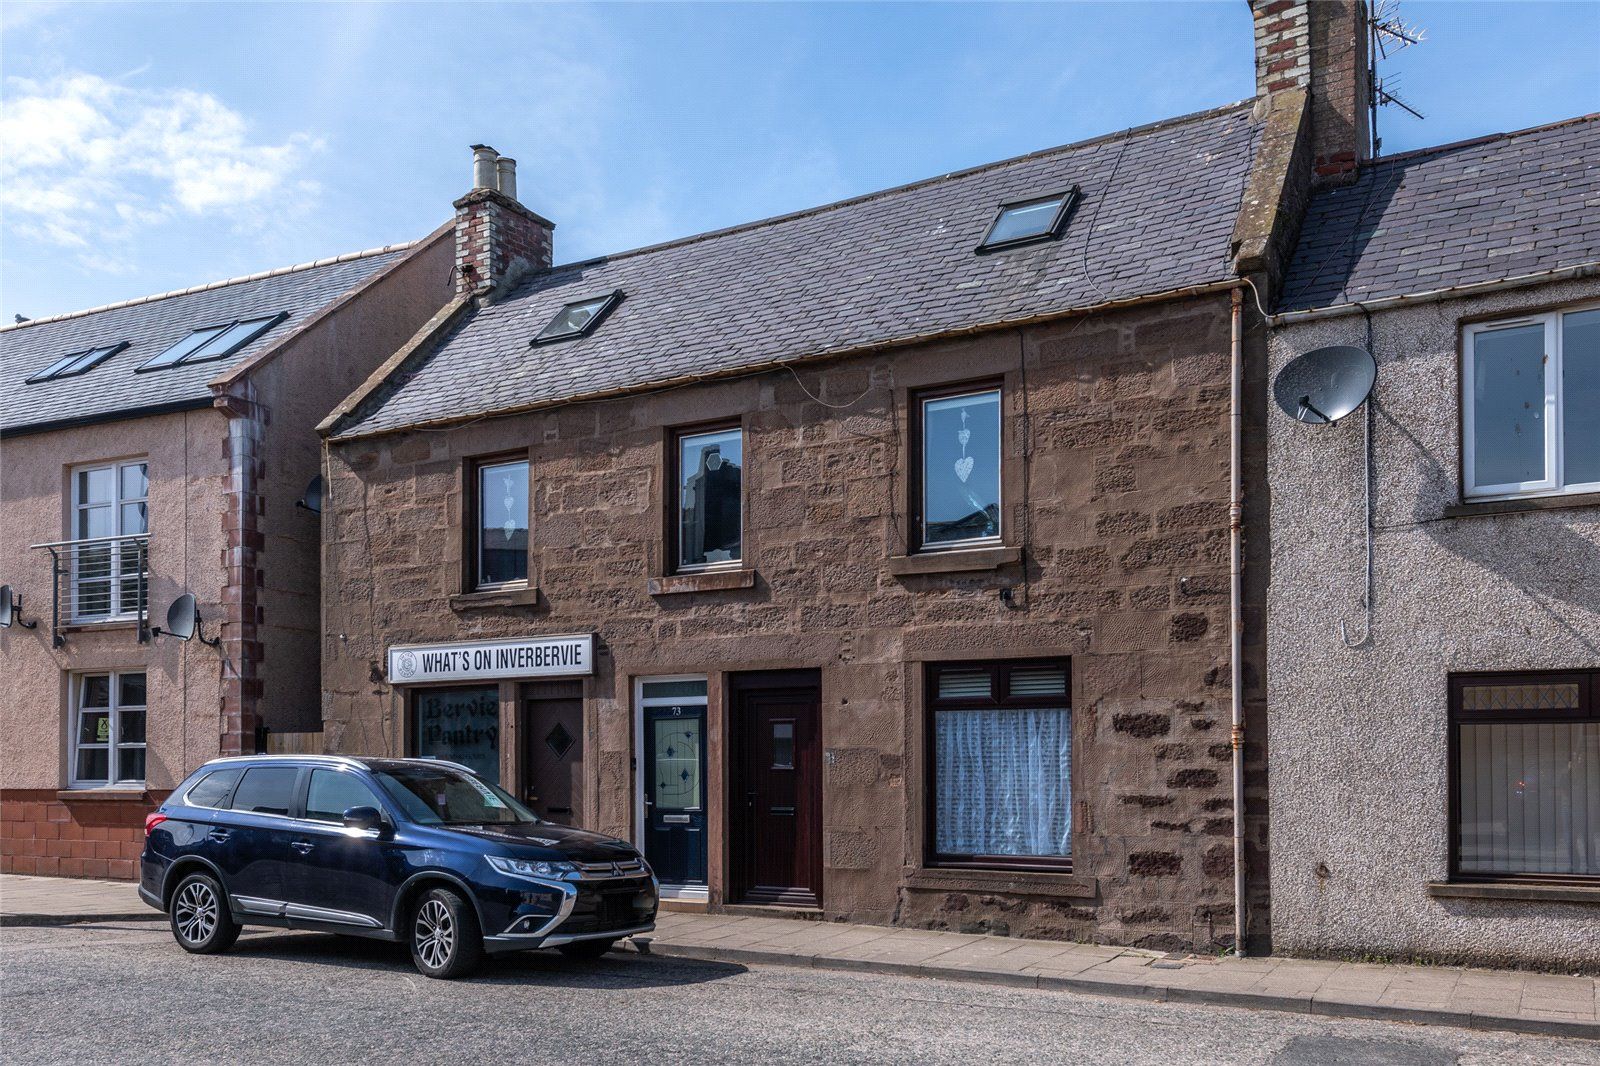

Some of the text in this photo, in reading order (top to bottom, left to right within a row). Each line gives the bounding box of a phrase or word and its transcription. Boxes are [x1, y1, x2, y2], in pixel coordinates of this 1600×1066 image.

[422, 650, 470, 673] WHAT'S
[474, 649, 492, 670] ON
[496, 643, 582, 669] INVERBERVIE
[426, 695, 498, 719] Bervie
[671, 706, 682, 717] 73
[426, 724, 498, 750] Pantry
